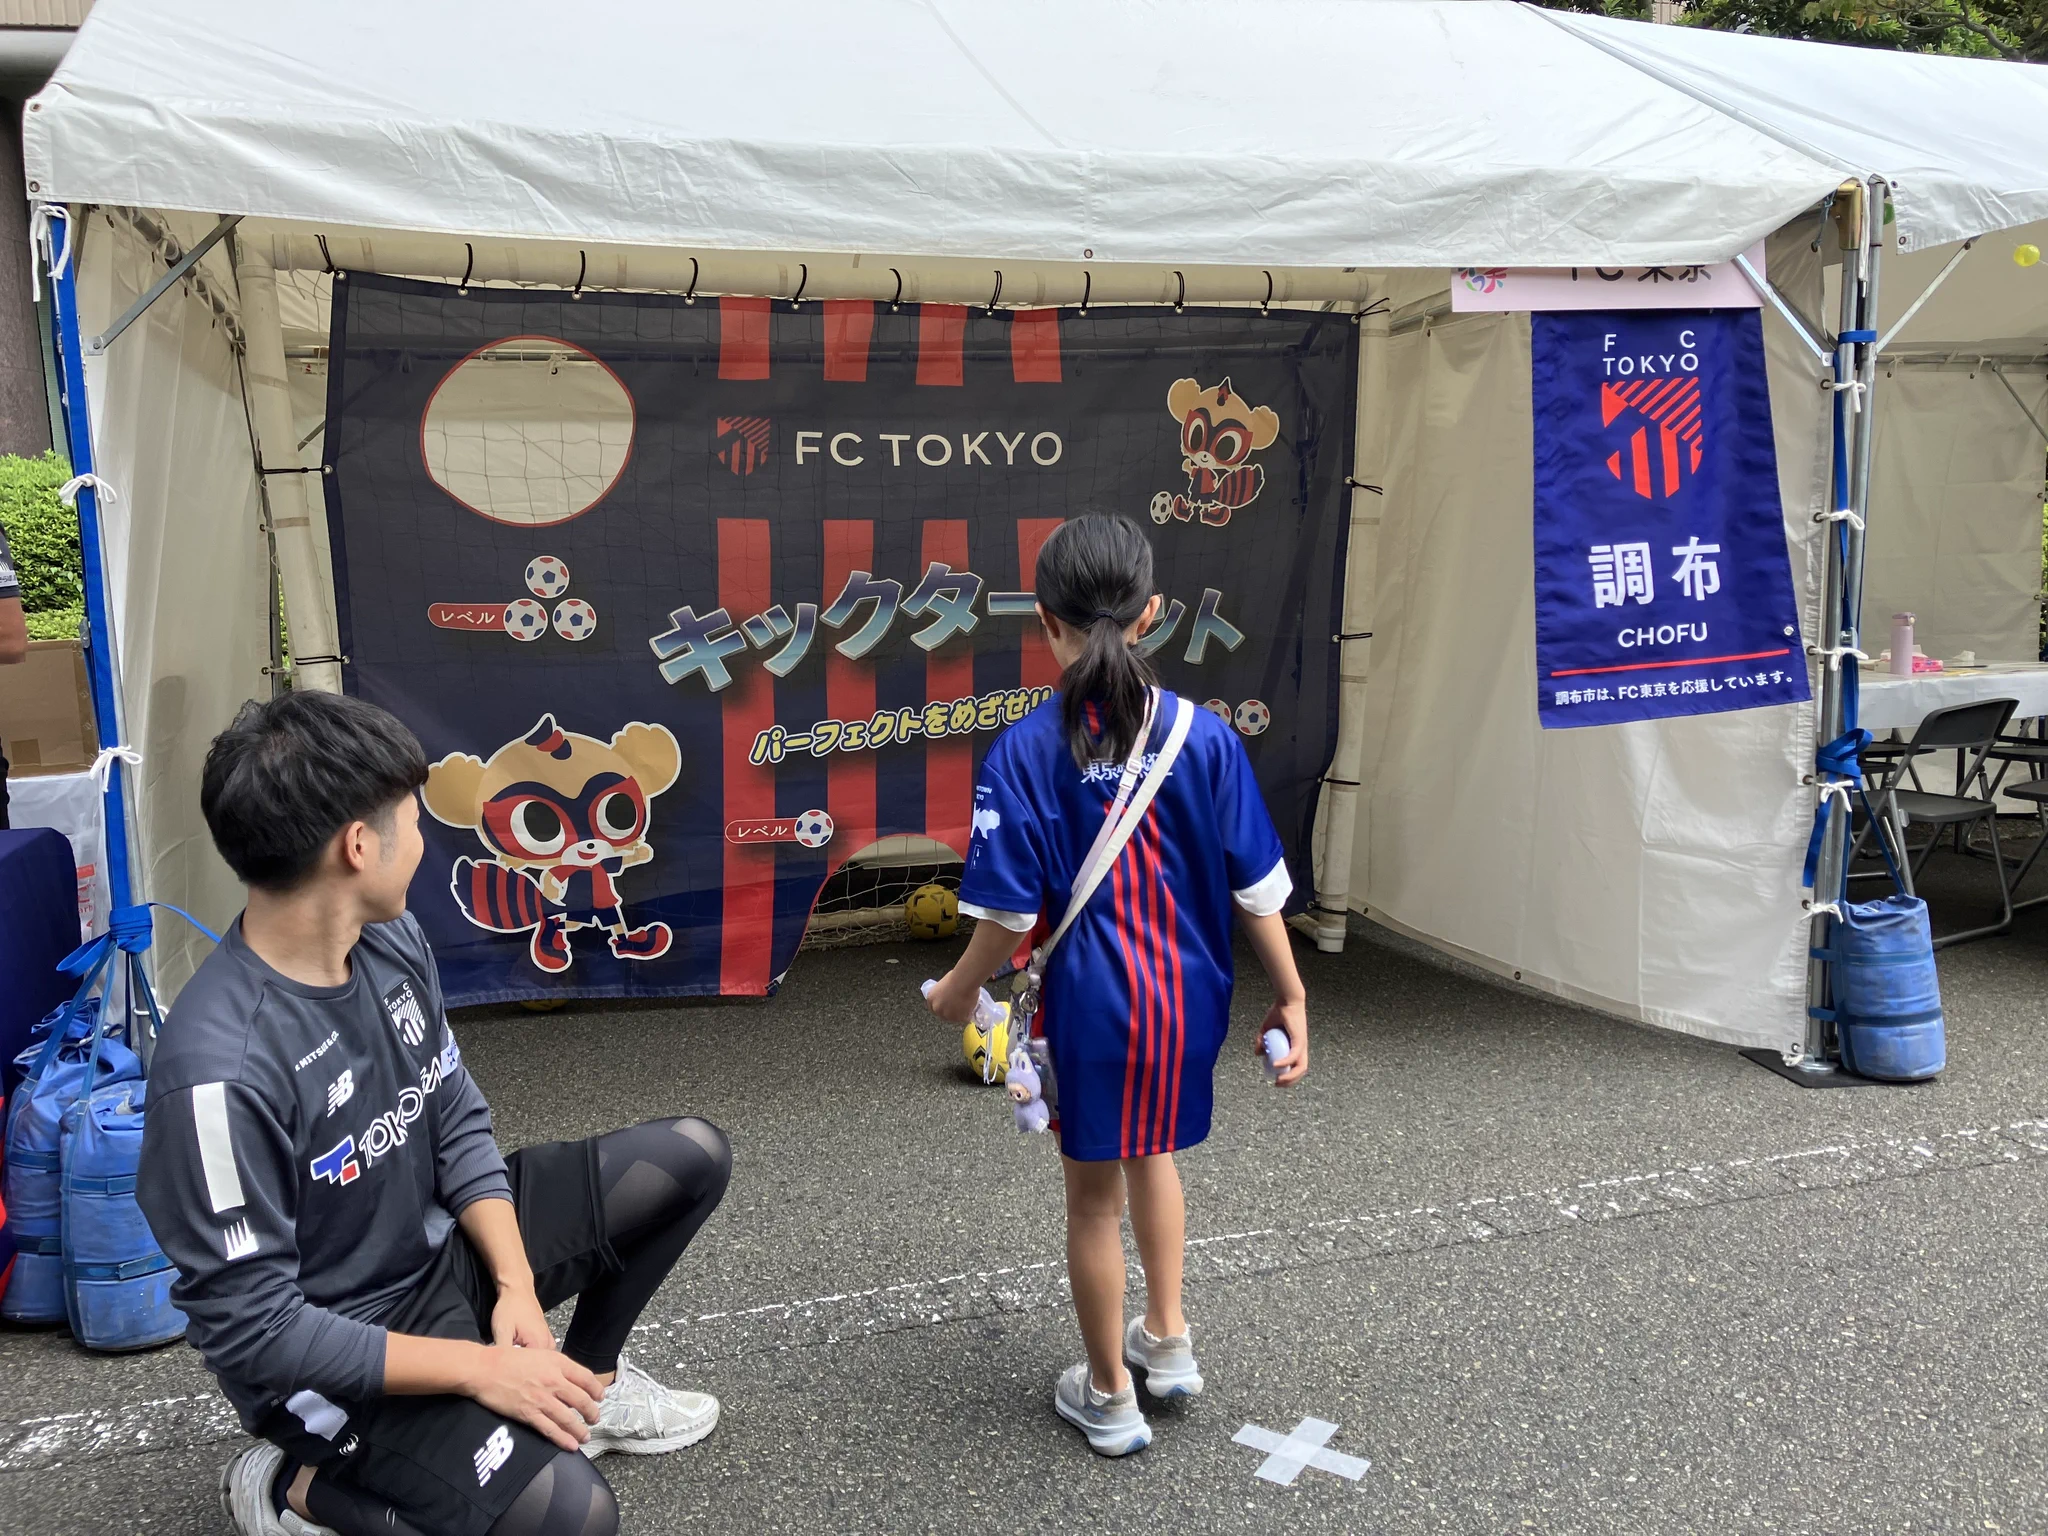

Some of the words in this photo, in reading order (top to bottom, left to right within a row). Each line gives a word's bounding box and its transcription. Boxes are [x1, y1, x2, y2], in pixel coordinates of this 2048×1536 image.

[1602, 353, 1699, 376] TOKYO
[795, 431, 864, 467] FC
[879, 431, 1063, 467] TOKYO
[1588, 536, 1721, 609] 調布
[441, 609, 496, 625] レベル
[649, 561, 1246, 692] キックターット
[1618, 622, 1708, 648] CHOFU
[1555, 670, 1794, 706] 調布市は、FC東京を応援しています。
[738, 825, 788, 838] レベル
[387, 989, 413, 1013] TOKYO
